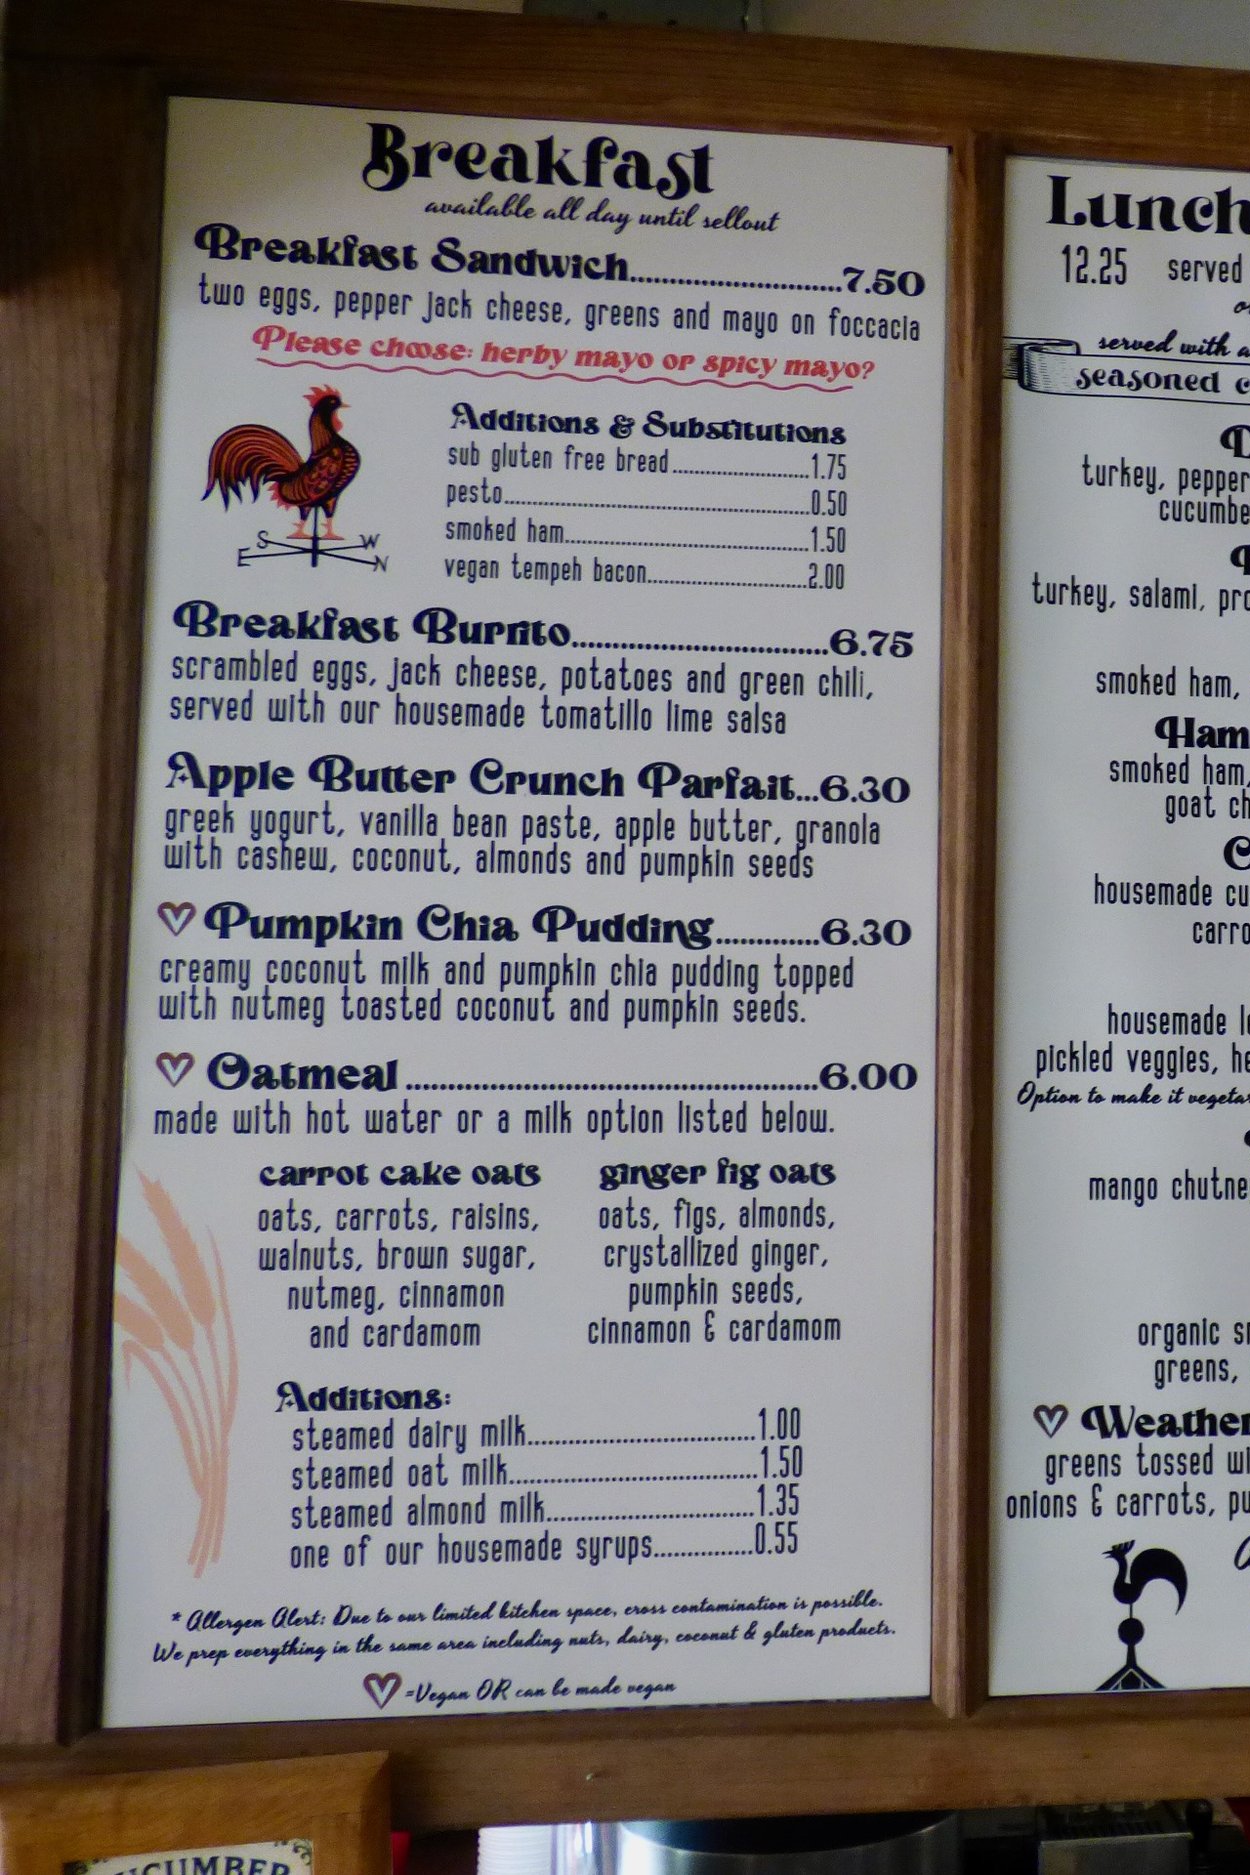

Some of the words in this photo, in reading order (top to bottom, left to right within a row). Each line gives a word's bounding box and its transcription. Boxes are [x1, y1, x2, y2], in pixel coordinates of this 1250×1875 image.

[362, 123, 714, 200] Breakfast
[424, 192, 536, 219] available
[543, 196, 585, 221] all
[585, 197, 632, 235] day
[639, 203, 700, 227] until
[703, 205, 780, 231] sellout
[194, 223, 419, 271] Breakfast
[1168, 253, 1242, 283] served
[199, 274, 244, 306] two
[259, 286, 320, 316] eggs,
[335, 291, 413, 320] pepper
[487, 291, 571, 325] cheese,
[585, 304, 659, 331] greens
[674, 301, 710, 330] and
[723, 310, 777, 339] mayo
[792, 313, 814, 335] on
[829, 307, 920, 341] foccacia
[251, 325, 362, 356] Please
[369, 337, 473, 361] choose:
[480, 341, 568, 370] herby
[574, 350, 654, 375] mayo
[662, 354, 696, 371] or
[702, 355, 778, 380] spicy
[783, 359, 875, 383] mayo?
[1098, 329, 1178, 353] served
[1180, 331, 1231, 357] with
[1076, 367, 1220, 394] seasoned
[450, 402, 600, 435] Additions
[609, 415, 635, 439] &
[642, 410, 847, 445] Substitutions
[449, 441, 480, 466] sub
[492, 442, 552, 472] gluten
[564, 444, 604, 471] free
[1155, 716, 1250, 749] Ham
[165, 751, 294, 798] Apple
[308, 754, 456, 793] Butter
[470, 758, 624, 797] Crunch
[204, 901, 403, 948] Pumpkin
[417, 904, 519, 942] Chia
[1017, 1081, 1082, 1112] Option
[1088, 1086, 1106, 1103] to
[1111, 1083, 1162, 1104] make
[1167, 1087, 1184, 1104] it
